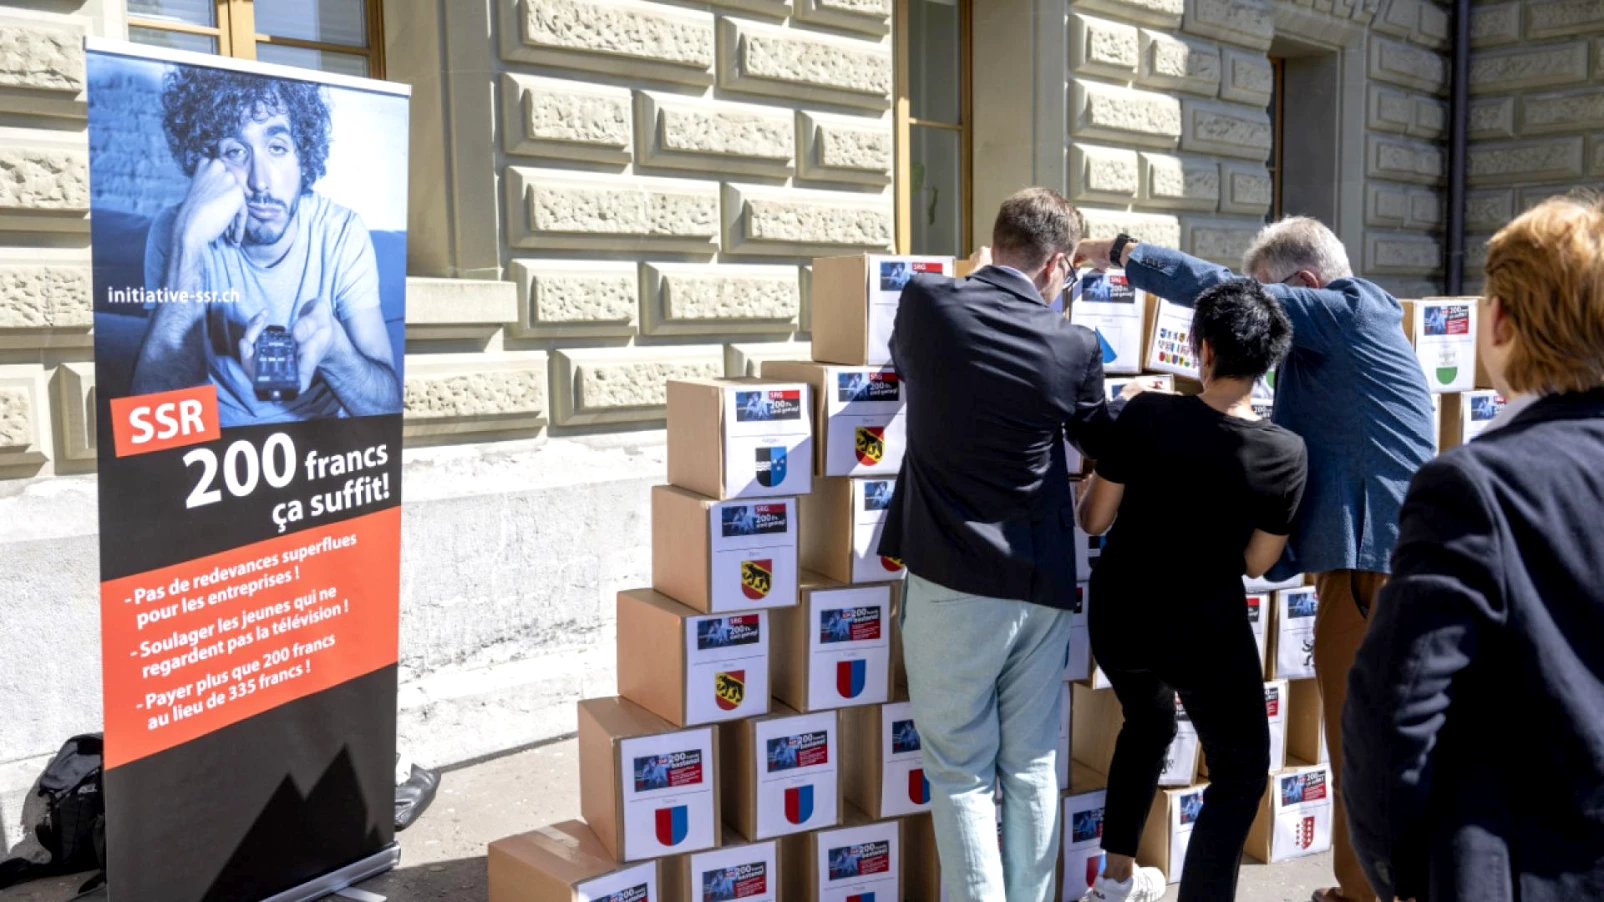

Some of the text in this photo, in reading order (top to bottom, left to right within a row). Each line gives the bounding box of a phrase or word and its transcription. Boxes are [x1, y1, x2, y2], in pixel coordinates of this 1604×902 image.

[107, 286, 240, 303] initiative-ssr.ch
[129, 399, 205, 444] SSR
[771, 400, 785, 410] 200
[183, 432, 389, 509] 200 francs
[272, 472, 390, 533] ça suffit!
[756, 514, 771, 523] 200
[134, 586, 165, 605] Pas
[168, 578, 191, 596] de
[193, 554, 279, 589] redevances
[282, 534, 357, 563] superflues
[136, 603, 178, 630] pour
[182, 594, 205, 613] les
[207, 570, 292, 605] entreprises
[140, 624, 215, 658] Soulager
[217, 617, 239, 634] les
[241, 600, 291, 630] jeunes
[293, 588, 317, 611] qui
[319, 586, 337, 601] ne
[852, 608, 867, 617] 200
[142, 641, 224, 679] regardent
[227, 632, 254, 655] pas
[256, 625, 270, 641] la
[272, 604, 341, 635] télévision
[730, 626, 745, 635] 200
[145, 684, 193, 710] Payer
[196, 671, 229, 696] plus
[231, 660, 260, 681] que
[262, 646, 290, 669] 200
[292, 634, 336, 658] francs
[147, 712, 169, 731] au
[172, 700, 204, 722] lieu
[206, 691, 226, 709] de
[228, 678, 257, 701] 335
[258, 664, 303, 689] francs
[669, 752, 686, 763] 200
[798, 733, 813, 744] 200
[736, 865, 752, 875] 200
